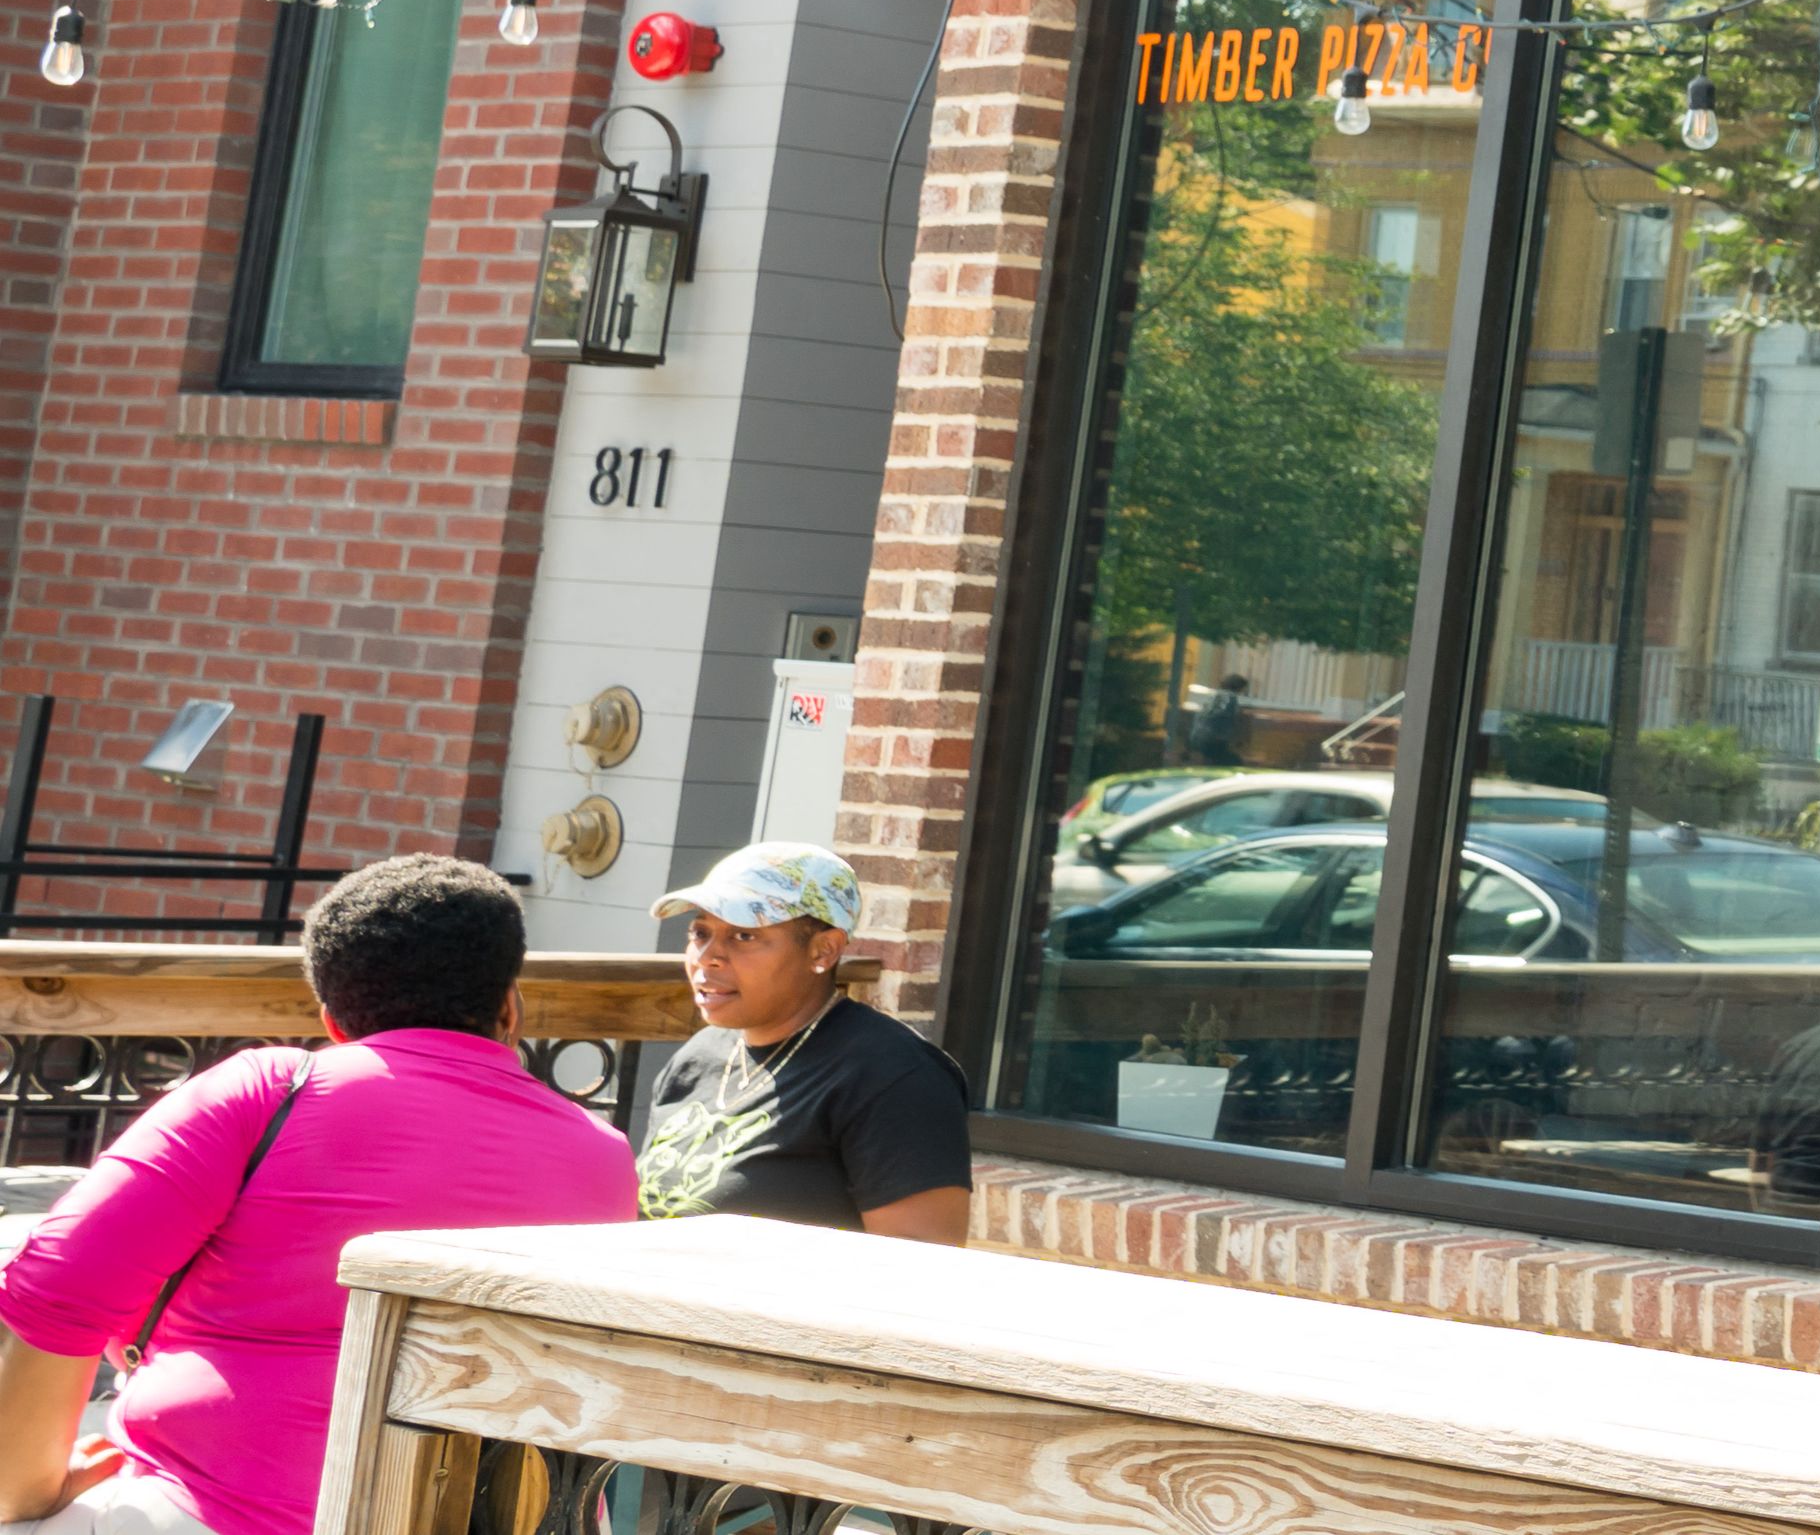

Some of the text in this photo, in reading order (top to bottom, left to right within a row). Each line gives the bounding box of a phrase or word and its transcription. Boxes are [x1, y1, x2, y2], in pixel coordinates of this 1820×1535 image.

[1136, 23, 1493, 105] TIMBER PIZZA C
[589, 447, 672, 508] 811
